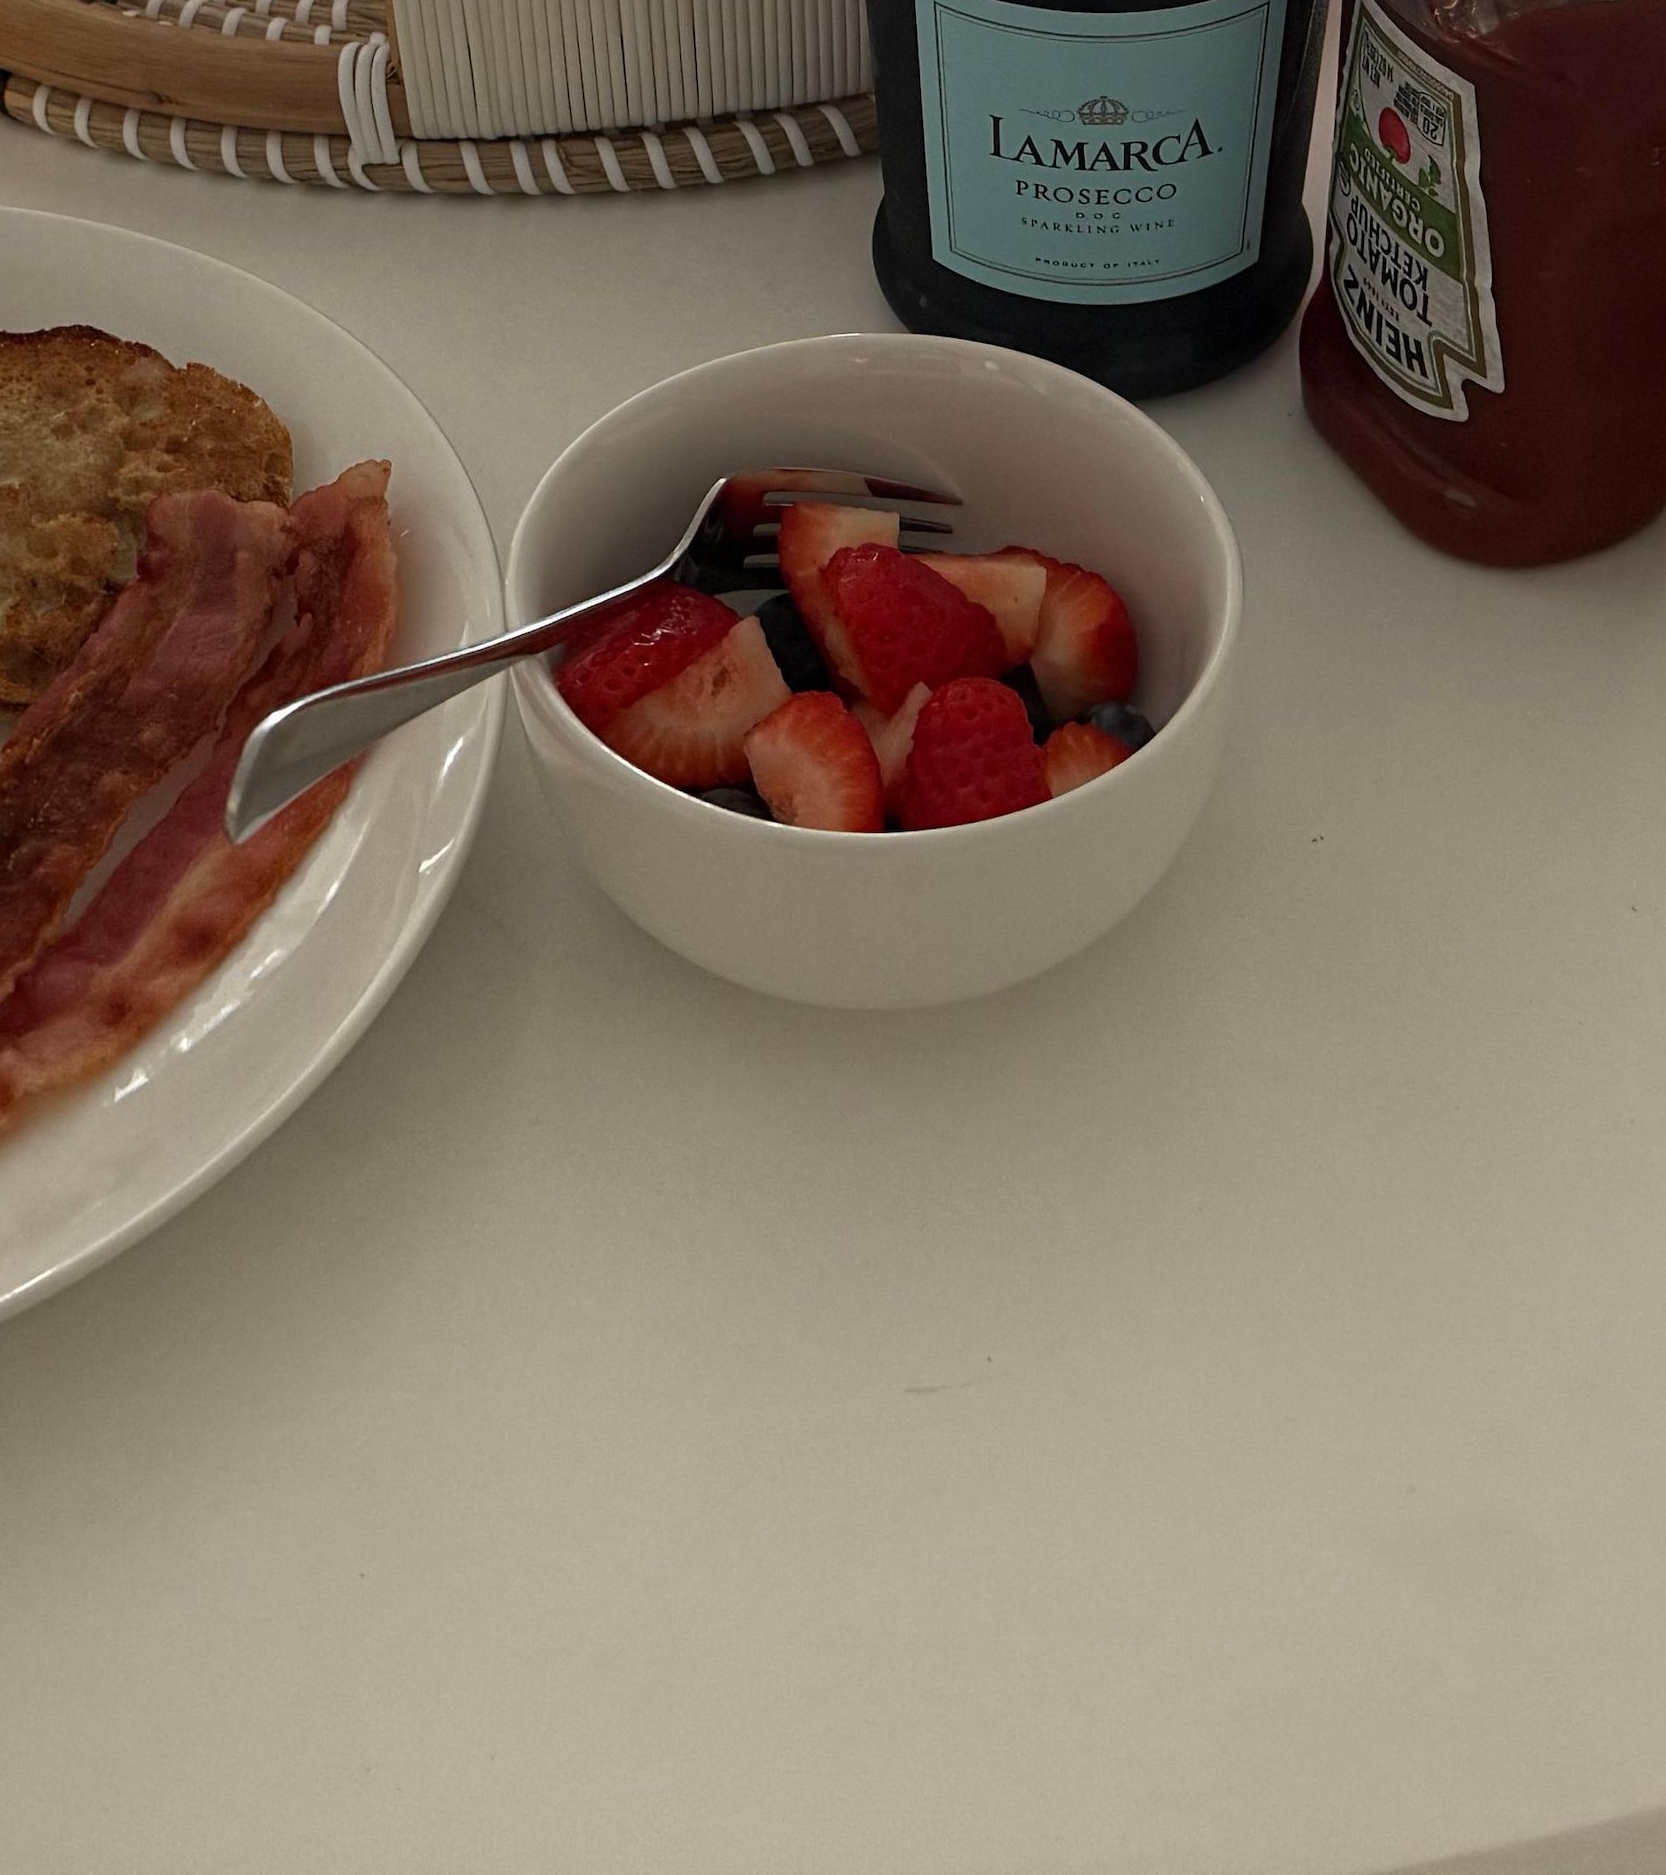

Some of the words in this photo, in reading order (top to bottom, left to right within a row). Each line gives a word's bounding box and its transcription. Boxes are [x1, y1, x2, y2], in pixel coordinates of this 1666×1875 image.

[1422, 116, 1439, 141] 20
[1014, 179, 1179, 206] PROSECCO
[1348, 142, 1446, 259] ORGANIC
[1363, 147, 1422, 213] CERTIFIED
[1020, 216, 1122, 235] SPARKLING
[1128, 218, 1177, 233] WINE
[1350, 194, 1429, 293] KETCHUP
[1034, 256, 1096, 270] PRODUCT
[1102, 261, 1121, 270] OF
[1126, 257, 1162, 269] ITALY
[1346, 211, 1433, 328] TOMATO
[1343, 263, 1429, 380] HEINZ
